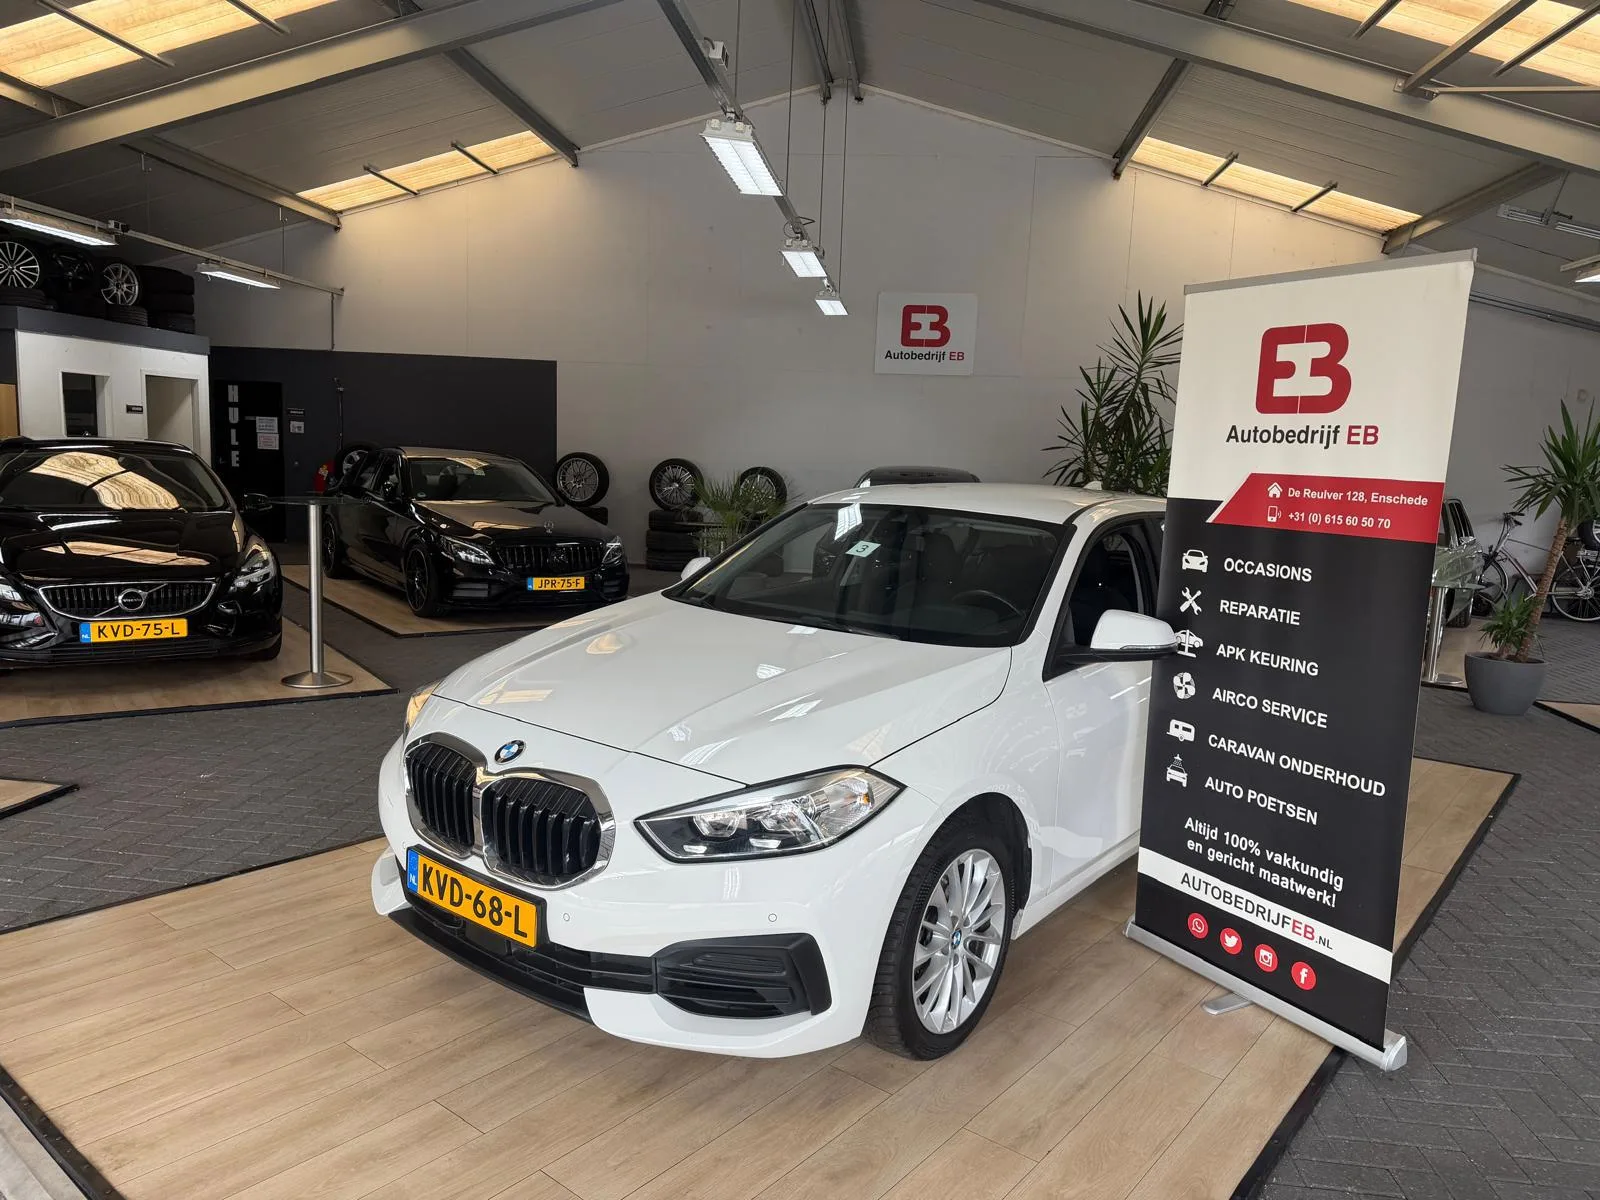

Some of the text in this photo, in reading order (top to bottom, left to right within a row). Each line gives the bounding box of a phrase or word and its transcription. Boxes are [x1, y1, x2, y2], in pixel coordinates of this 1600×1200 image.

[884, 350, 965, 362] Autobedrijf EB
[1226, 424, 1379, 449] Autobedrijf EB
[1288, 488, 1301, 498] De
[1346, 491, 1368, 504] 128,
[1371, 492, 1428, 506] Enschede
[1288, 512, 1391, 529] +31 (0) 615 60 50 70
[856, 544, 869, 553] 3
[1224, 557, 1312, 582] OCCASIONS
[538, 578, 580, 588] JPR-75-F
[1220, 600, 1300, 626] REPARATIE
[98, 622, 180, 638] KVD-75-L
[1216, 644, 1319, 676] APK KEURING
[1212, 687, 1328, 729] AIRCO SERVICE
[1208, 734, 1386, 798] CARAVAN ONDERHOUD
[1204, 776, 1318, 826] AUTO POETSEN
[1184, 817, 1344, 891] Altijd 100% vakkundig
[409, 874, 418, 886] NL
[1187, 838, 1337, 908] en gericht maatwerk!
[422, 863, 528, 938] KVD-68-L
[1180, 871, 1334, 950] AUTOBEDRIJFEB.NL
